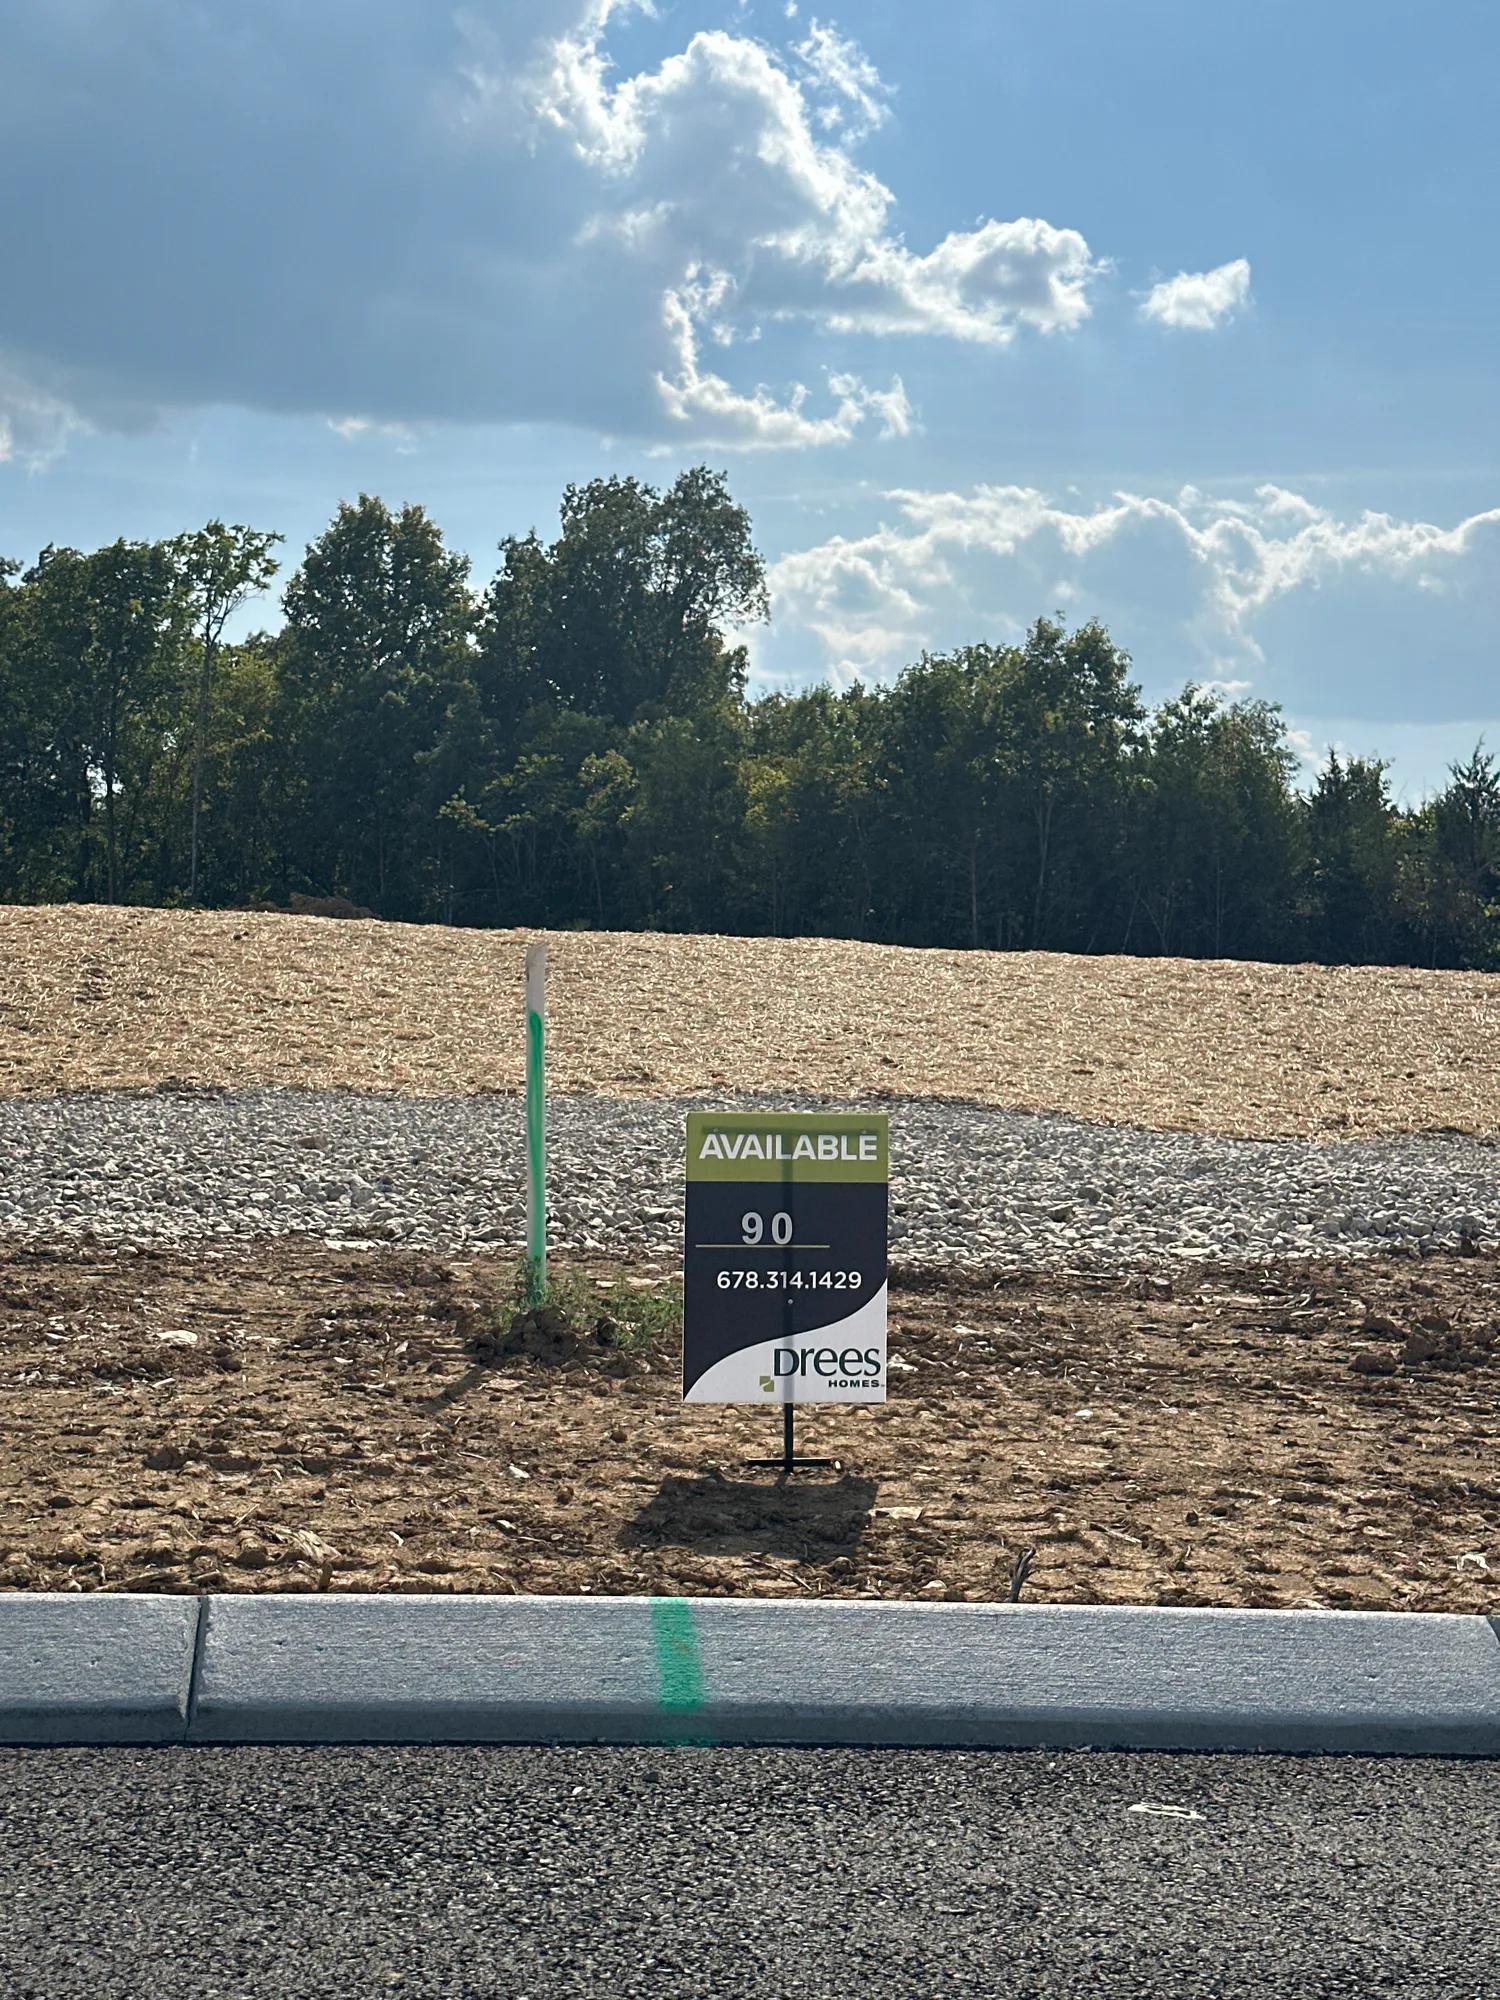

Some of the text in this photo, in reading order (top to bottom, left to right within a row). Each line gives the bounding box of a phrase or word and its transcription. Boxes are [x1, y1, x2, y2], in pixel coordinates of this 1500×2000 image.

[699, 1134, 878, 1161] AVAILABLE
[741, 1212, 793, 1245] 90
[716, 1271, 862, 1289] 678.314.1429
[773, 1347, 881, 1377] Drees
[828, 1379, 880, 1388] HOMES
